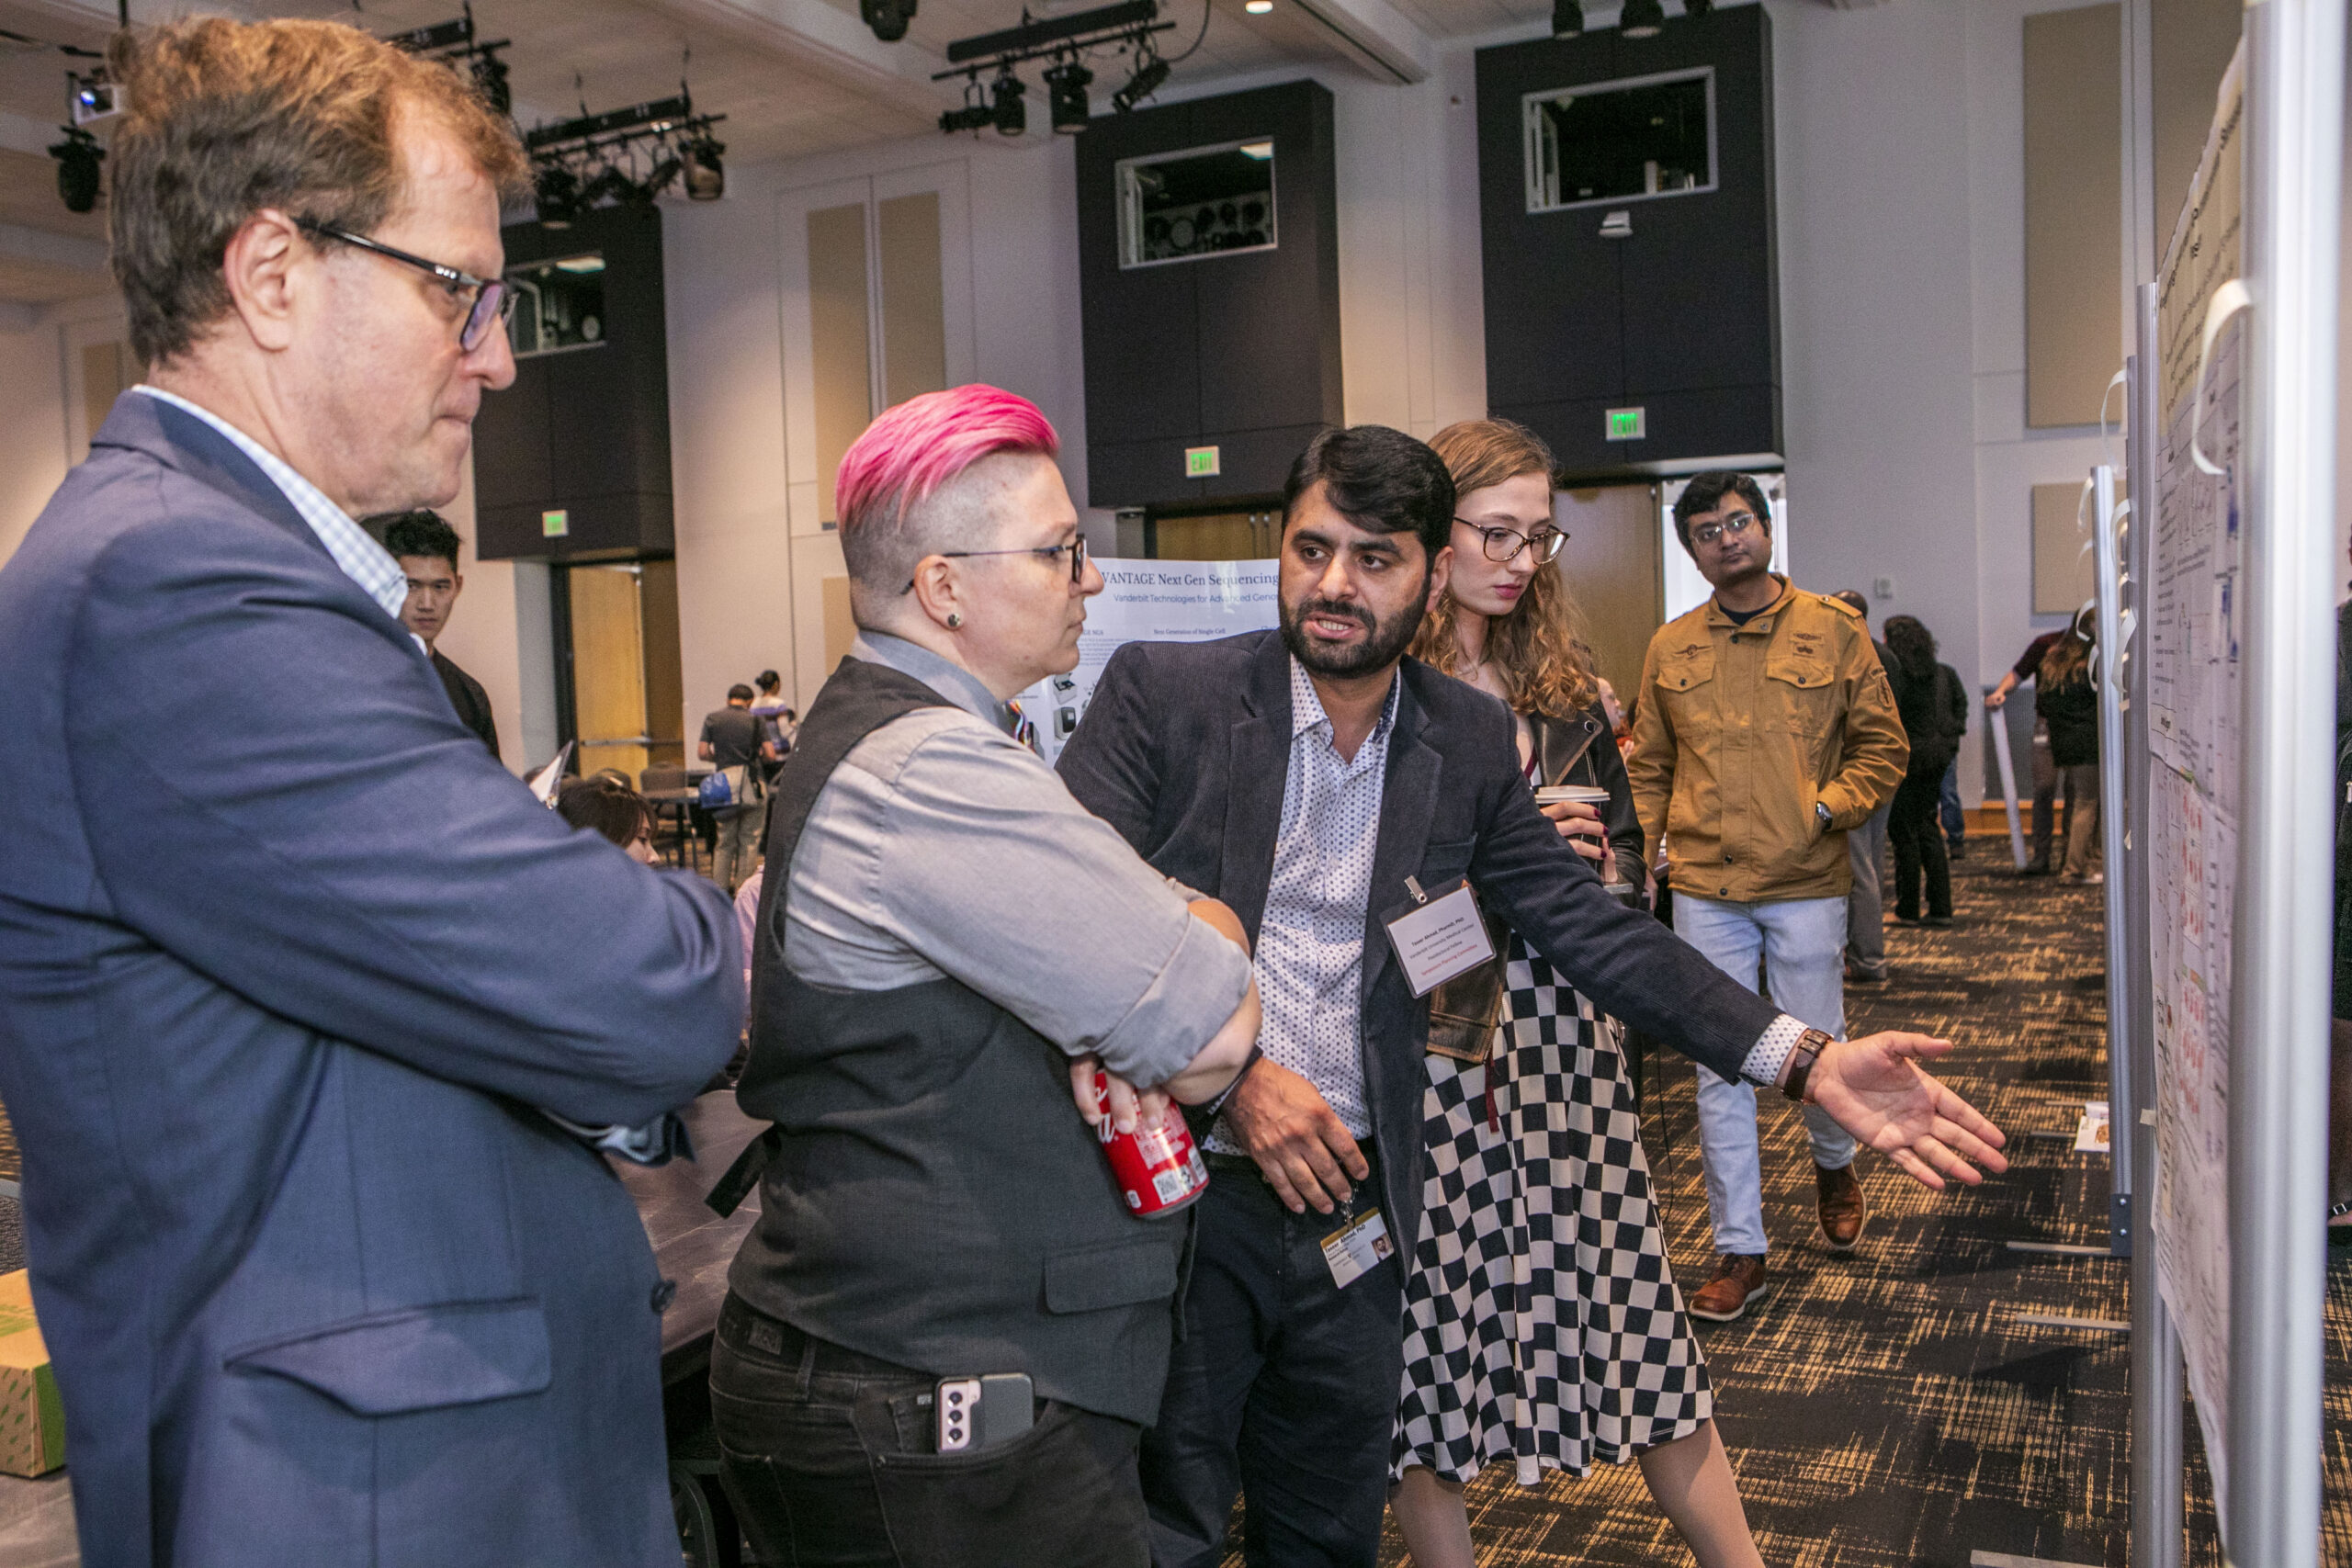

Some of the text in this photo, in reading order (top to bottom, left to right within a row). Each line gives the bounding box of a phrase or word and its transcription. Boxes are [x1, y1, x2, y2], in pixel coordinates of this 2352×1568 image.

[1612, 412, 1637, 435] EXIT
[1191, 452, 1213, 471] EXIT
[1102, 571, 1279, 589] VANTAGE Next Gen Sequencing
[1114, 593, 1148, 603] Vanderbilt
[1150, 593, 1196, 604] Technologies
[1197, 594, 1207, 603] for
[1252, 592, 1279, 602] Geno
[1356, 1224, 1366, 1234] PhD
